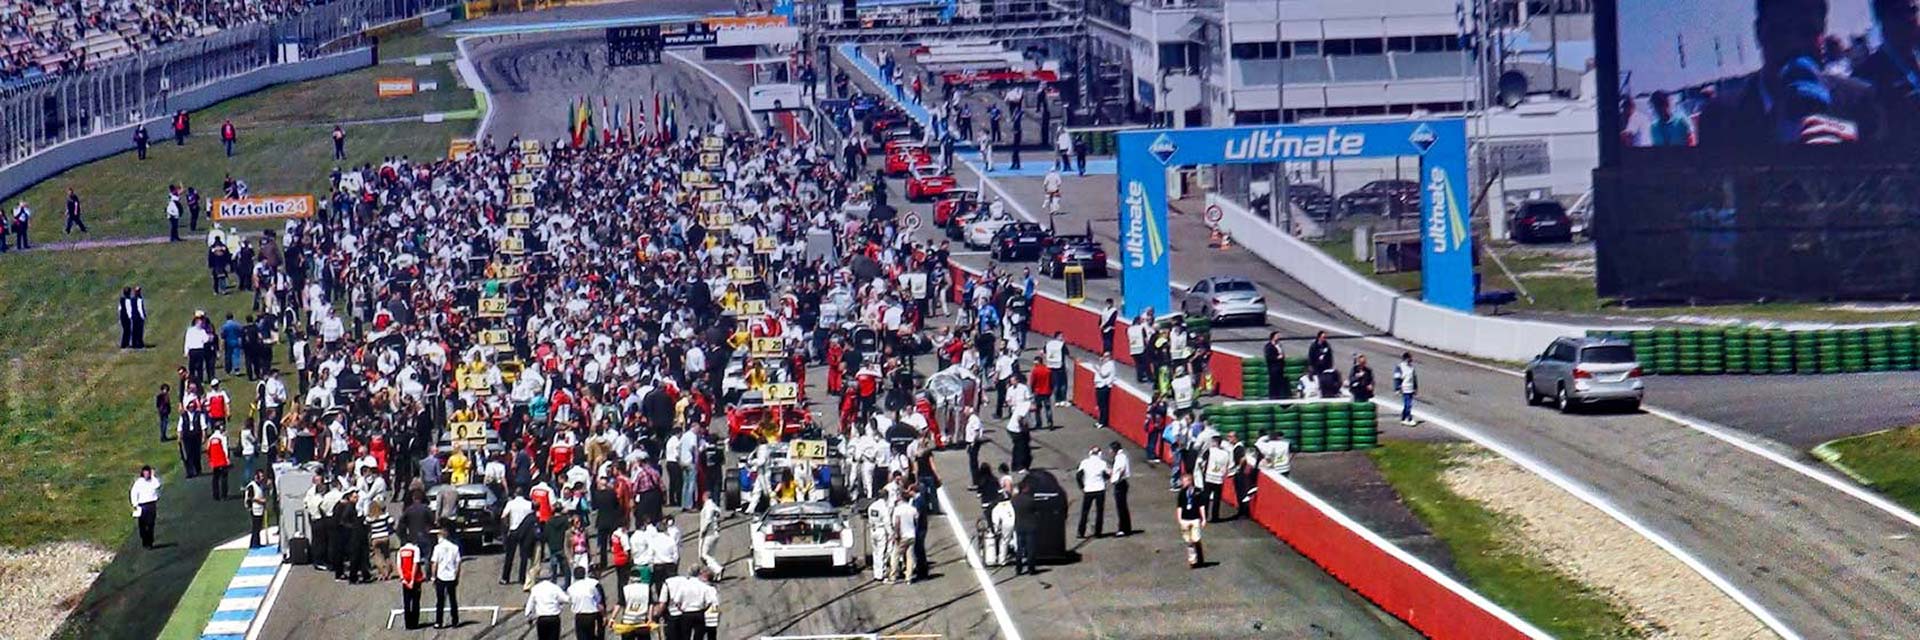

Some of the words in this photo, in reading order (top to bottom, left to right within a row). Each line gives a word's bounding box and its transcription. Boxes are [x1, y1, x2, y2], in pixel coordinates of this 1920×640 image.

[1225, 127, 1365, 162] ultimate
[221, 200, 307, 217] kfzteile24
[1426, 167, 1446, 253] ultimate
[1126, 181, 1144, 268] ultimate
[788, 387, 794, 397] 2
[814, 445, 825, 456] 21
